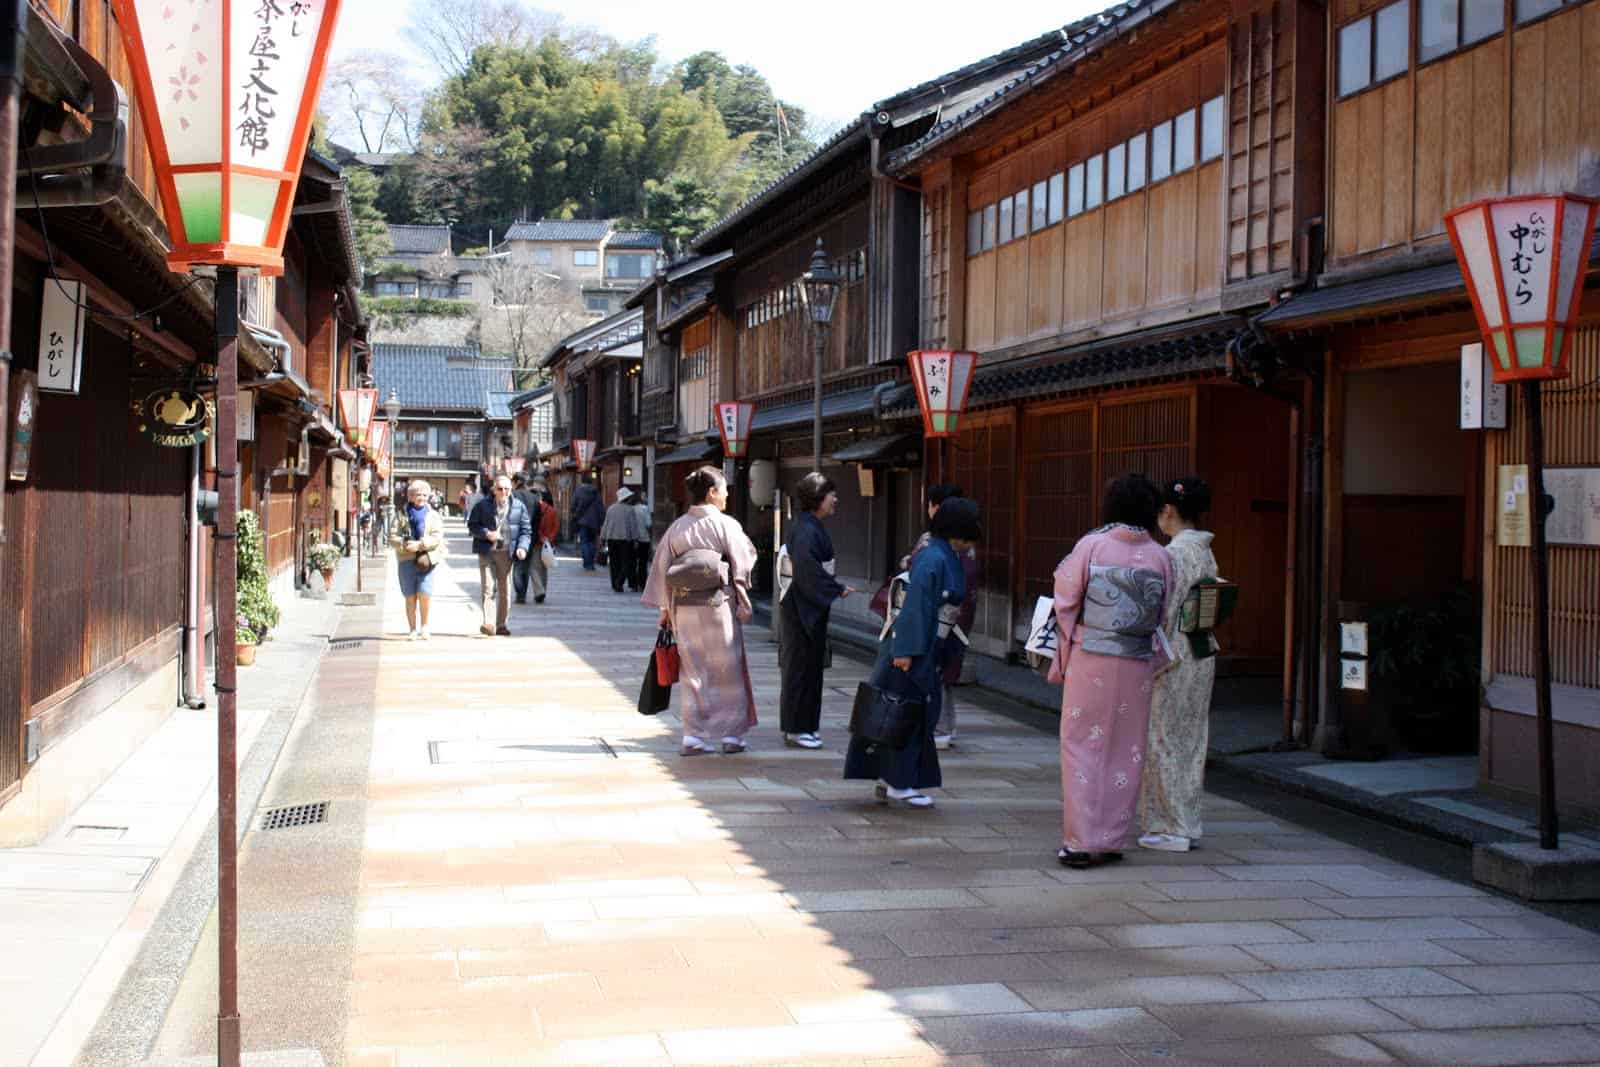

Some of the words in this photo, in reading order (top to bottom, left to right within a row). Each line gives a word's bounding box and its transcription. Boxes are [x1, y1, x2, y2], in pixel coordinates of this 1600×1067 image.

[1530, 212, 1546, 254] ひがし
[1508, 222, 1533, 305] 中むら
[48, 332, 63, 377] ひがし
